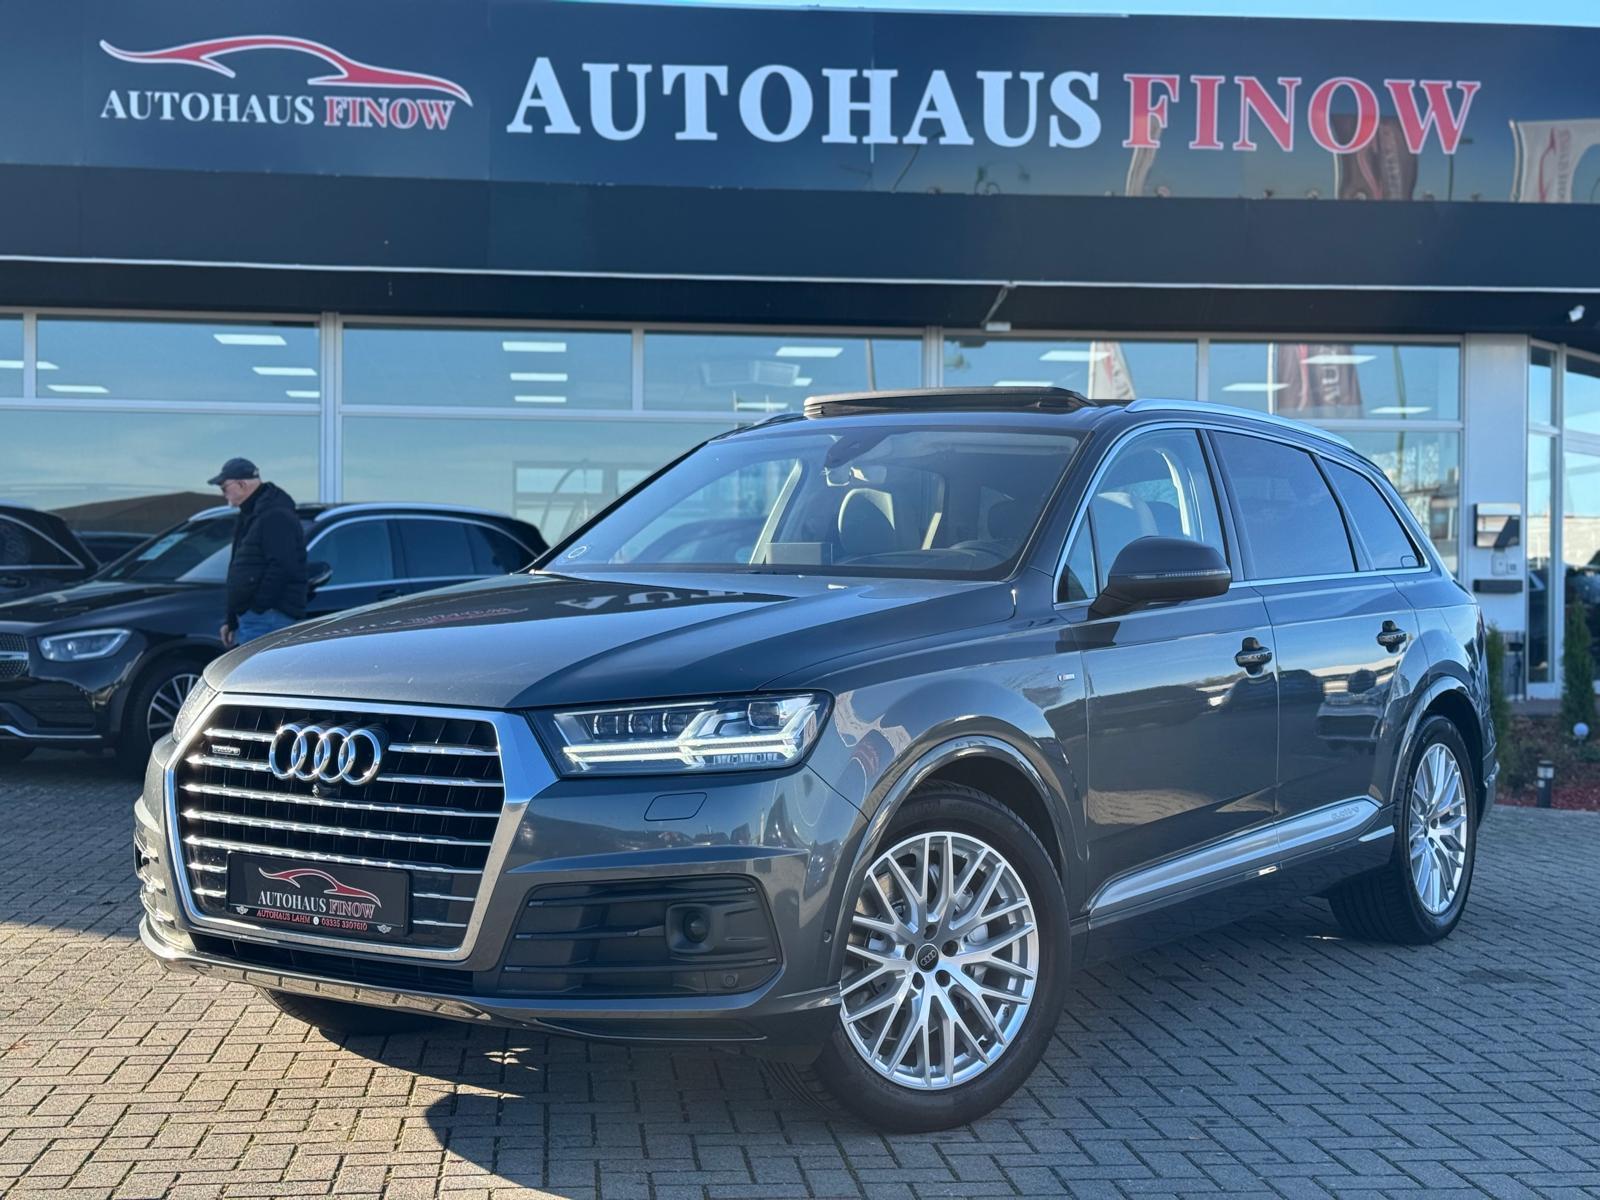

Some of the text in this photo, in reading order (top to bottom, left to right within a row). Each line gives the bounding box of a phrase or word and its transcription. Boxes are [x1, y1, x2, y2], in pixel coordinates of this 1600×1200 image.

[100, 90, 456, 130] AUTOHAUS FINOW
[506, 57, 1481, 155] AUTOHAUS FINOW
[256, 909, 291, 921] AUTOHAUS
[258, 890, 376, 919] AUTOHAUS FINOW
